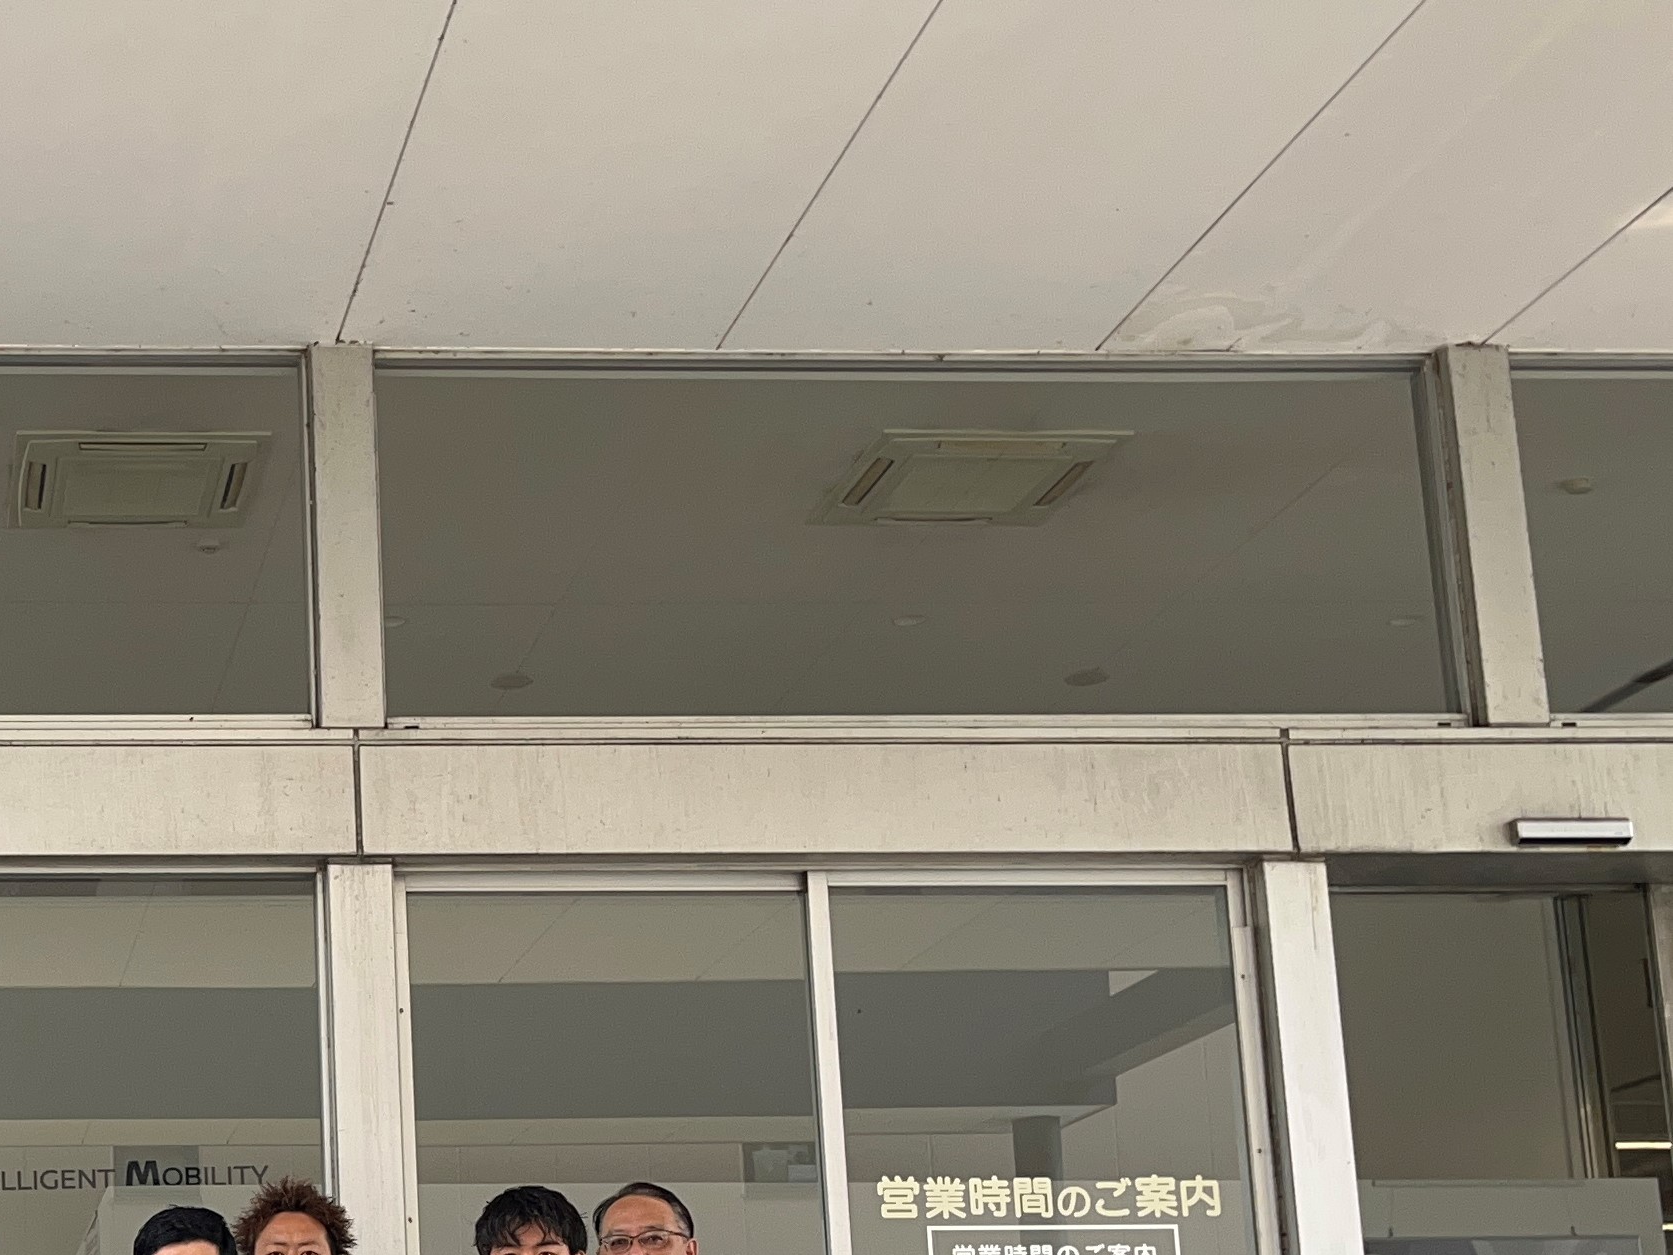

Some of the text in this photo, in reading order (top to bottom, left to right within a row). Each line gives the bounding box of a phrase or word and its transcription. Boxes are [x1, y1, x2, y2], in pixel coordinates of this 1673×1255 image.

[125, 1160, 269, 1186] MOBILITY
[876, 1174, 1223, 1220] 営業時間のご案内
